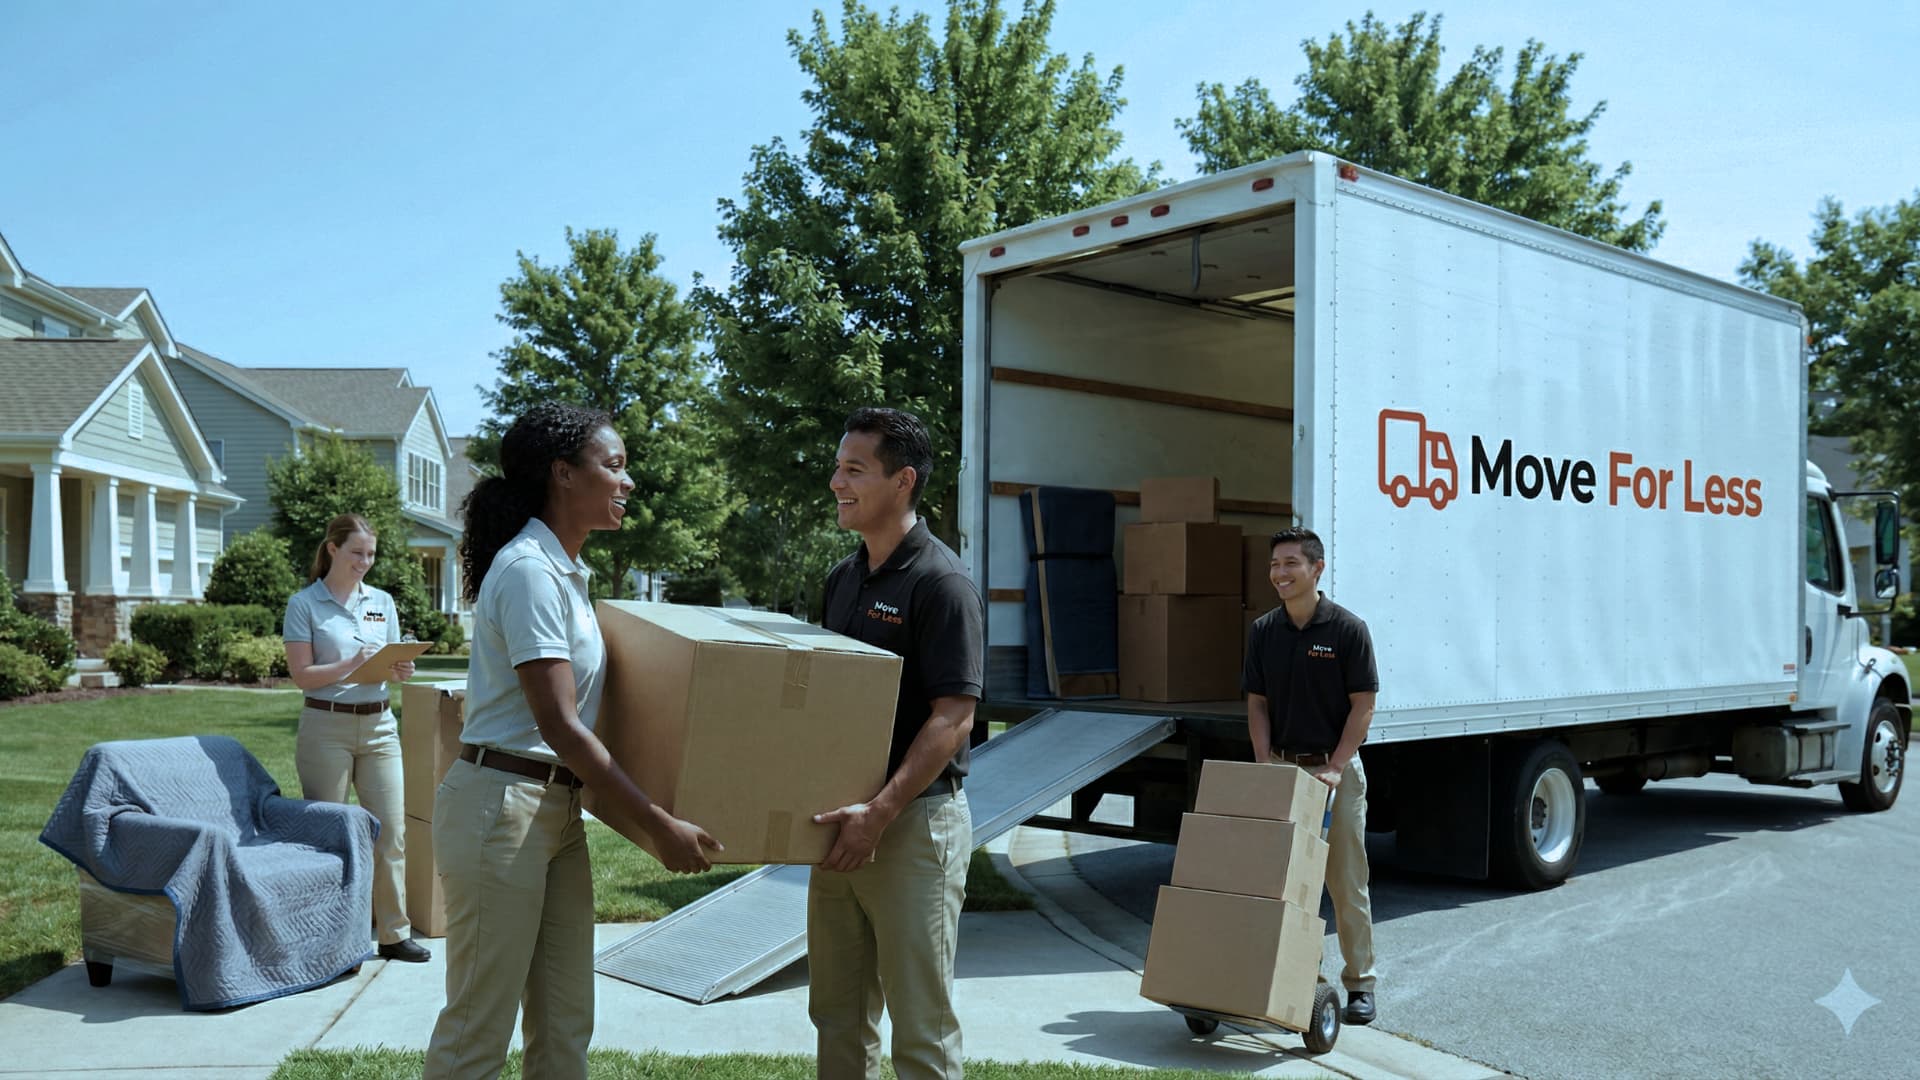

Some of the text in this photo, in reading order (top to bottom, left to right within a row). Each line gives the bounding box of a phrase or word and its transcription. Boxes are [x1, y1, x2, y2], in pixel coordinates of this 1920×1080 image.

[1471, 435, 1762, 518] Move For Less
[874, 601, 899, 614] Move
[882, 612, 903, 624] Less
